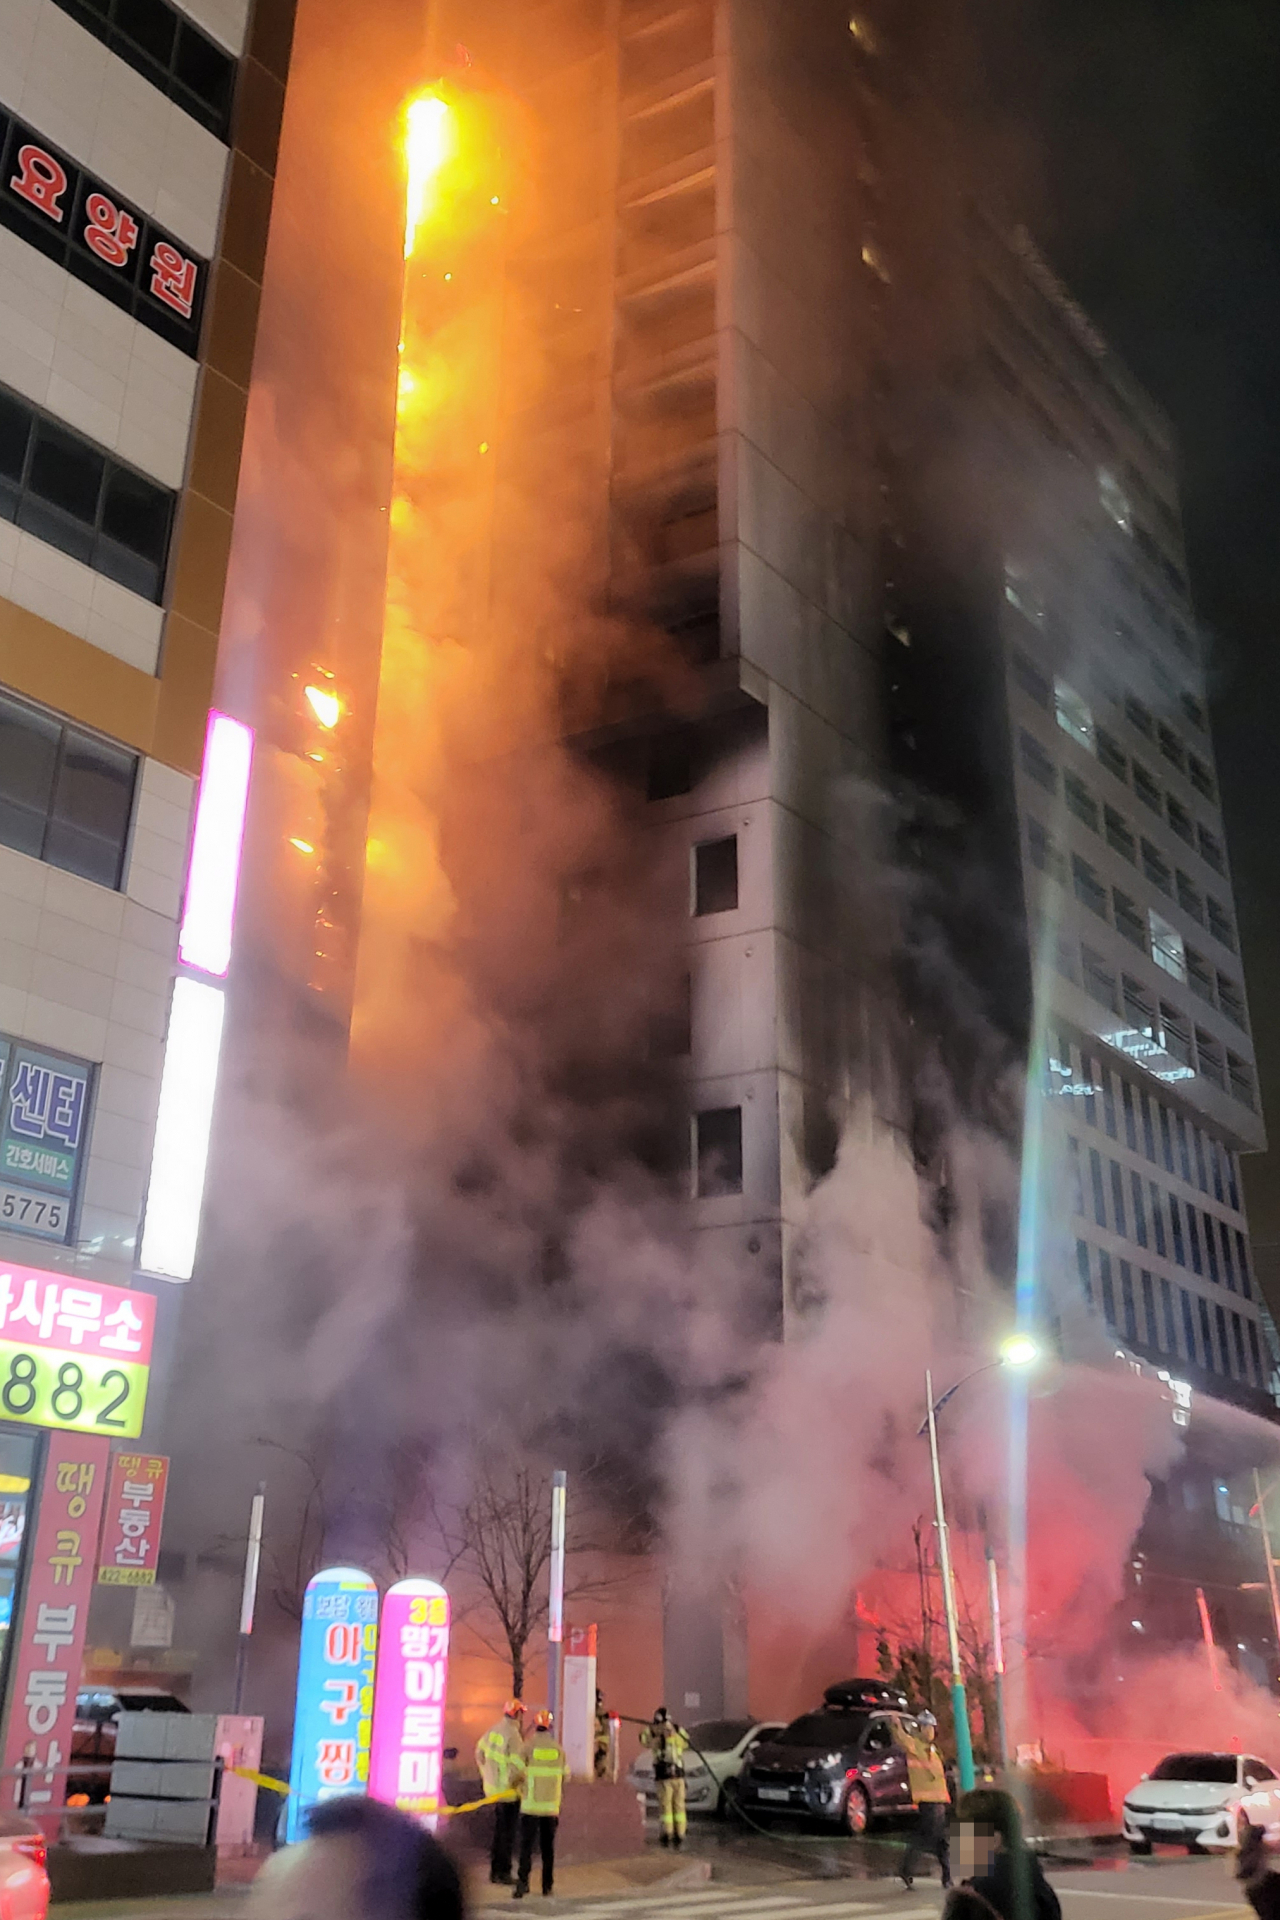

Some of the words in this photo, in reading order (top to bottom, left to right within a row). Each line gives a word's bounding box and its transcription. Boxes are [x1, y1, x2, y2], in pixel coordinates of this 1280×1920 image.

[10, 144, 198, 319] 요양원
[9, 1061, 87, 1149] 센터
[5, 1144, 70, 1180] 간호서비스
[2, 1194, 62, 1228] 5775
[2, 1353, 131, 1428] 882
[115, 1480, 154, 1566] 부동산
[399, 1660, 445, 1794] 아로마
